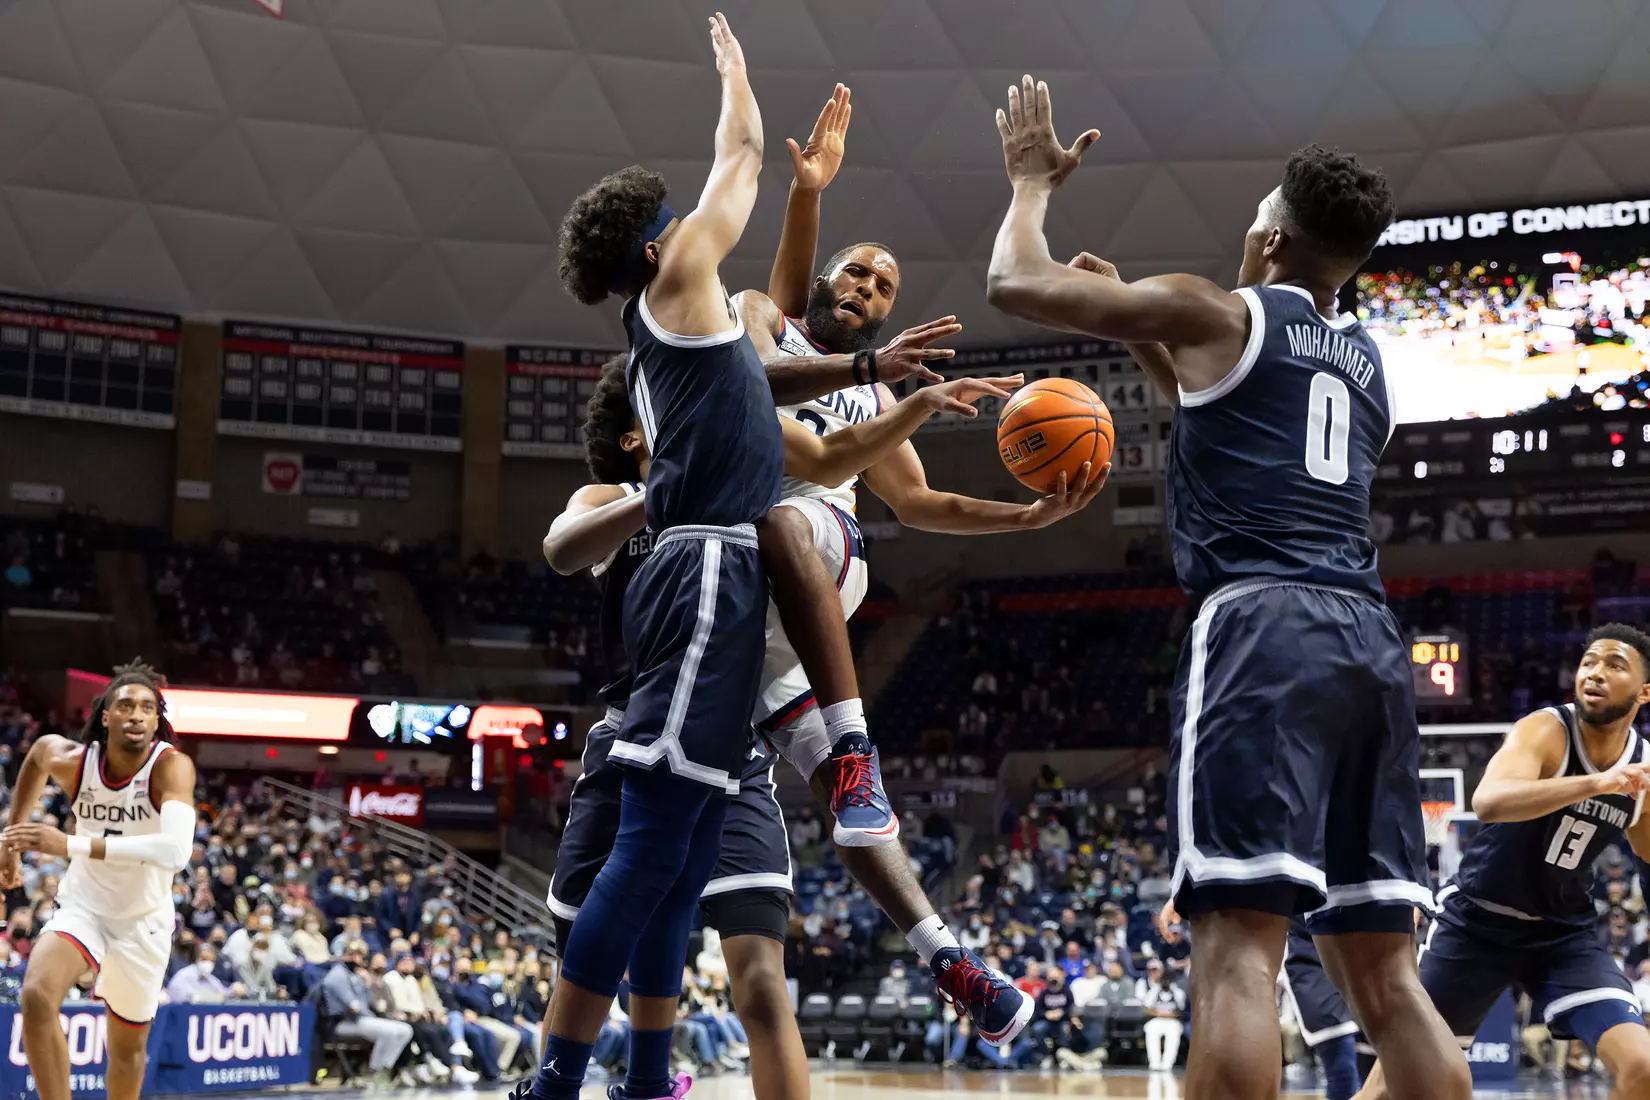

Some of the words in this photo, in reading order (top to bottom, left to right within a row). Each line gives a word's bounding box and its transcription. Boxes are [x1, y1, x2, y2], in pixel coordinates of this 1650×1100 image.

[1468, 211, 1508, 239] OF
[1513, 200, 1650, 235] CONNECT
[1285, 324, 1375, 390] MOHAMMED
[1113, 384, 1144, 405] 44
[1305, 371, 1350, 486] 0
[1002, 431, 1047, 463] ELITE
[1118, 446, 1143, 467] 13
[1431, 662, 1454, 696] 9
[1544, 814, 1598, 870] 13
[188, 1012, 298, 1063] UCONN
[203, 1065, 280, 1085] BASKETBALL
